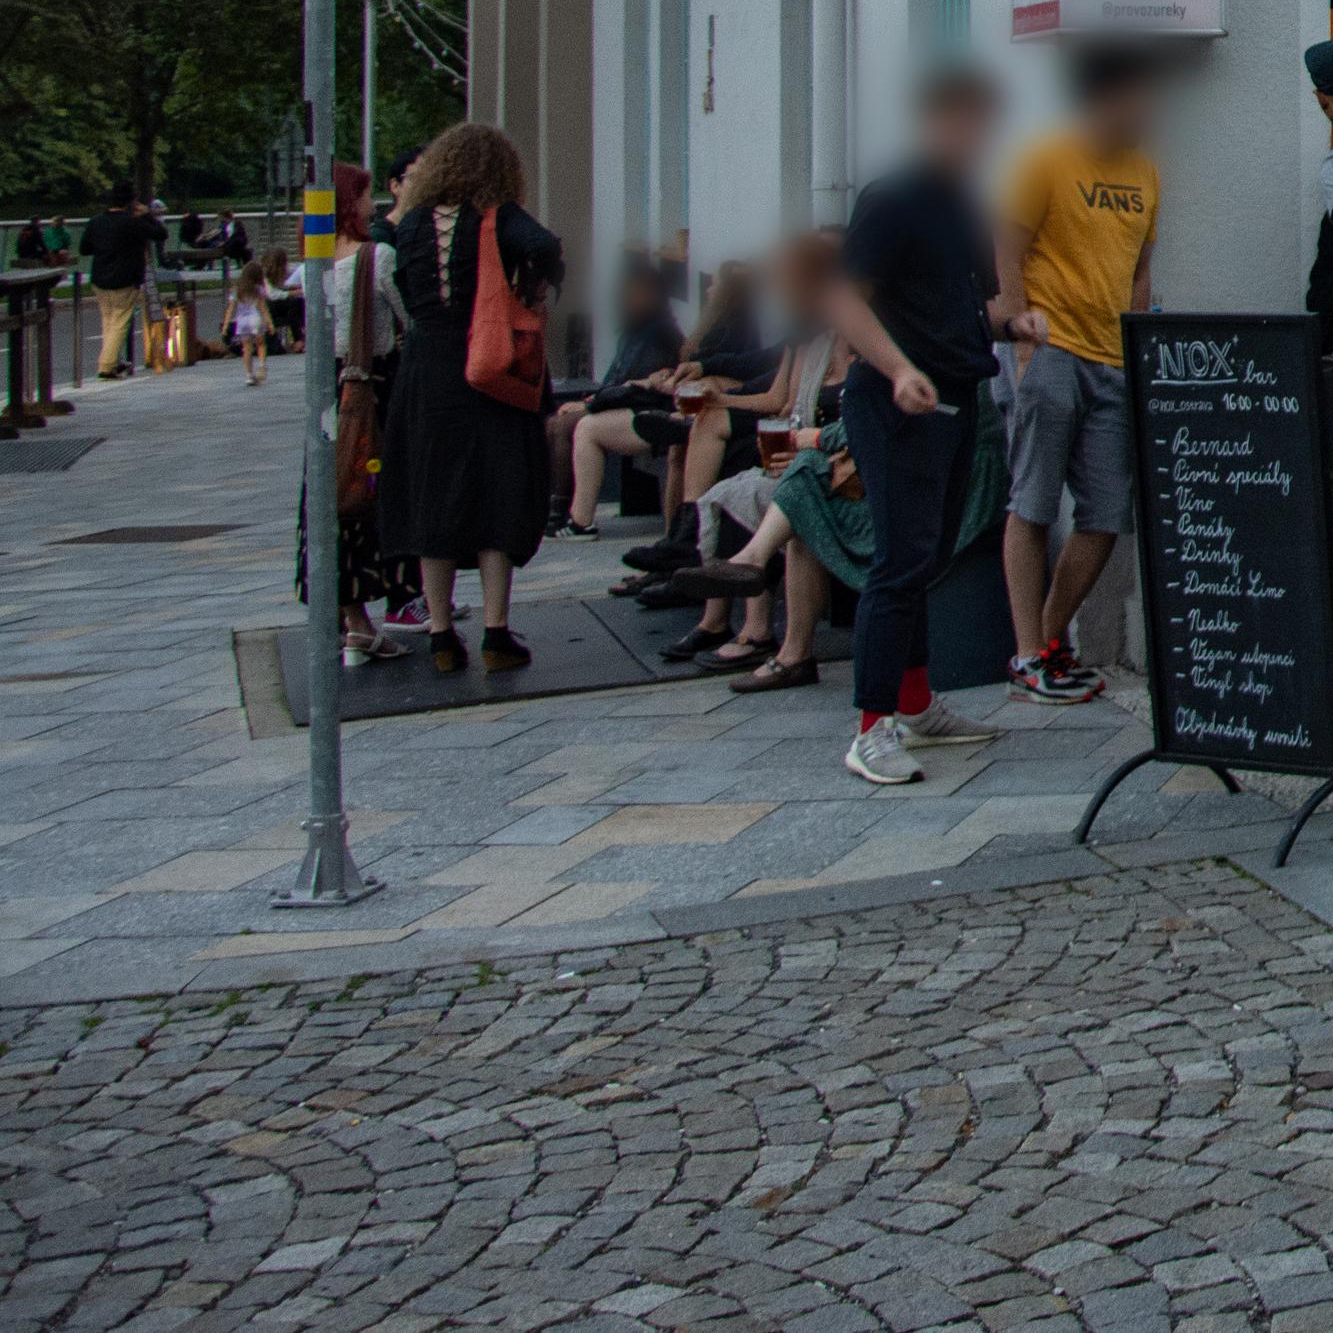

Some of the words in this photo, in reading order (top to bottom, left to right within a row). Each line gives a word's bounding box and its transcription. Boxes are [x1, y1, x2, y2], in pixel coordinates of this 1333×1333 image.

[1102, 1, 1187, 20] @provozureky
[1076, 180, 1145, 214] VANS
[1158, 340, 1234, 380] NOX
[1243, 359, 1278, 385] bar
[1172, 426, 1254, 456] Bernard
[1174, 458, 1220, 483] Pivní
[1225, 459, 1293, 497] speciály
[1178, 512, 1235, 544] Panáky
[1181, 539, 1243, 576] Drinky
[1184, 570, 1242, 597] Domácí
[1246, 570, 1286, 598] Limo
[1188, 608, 1241, 633] Nealko
[1190, 638, 1237, 671] Vegan
[1191, 666, 1233, 699] Vinyl
[1238, 671, 1273, 705] shop
